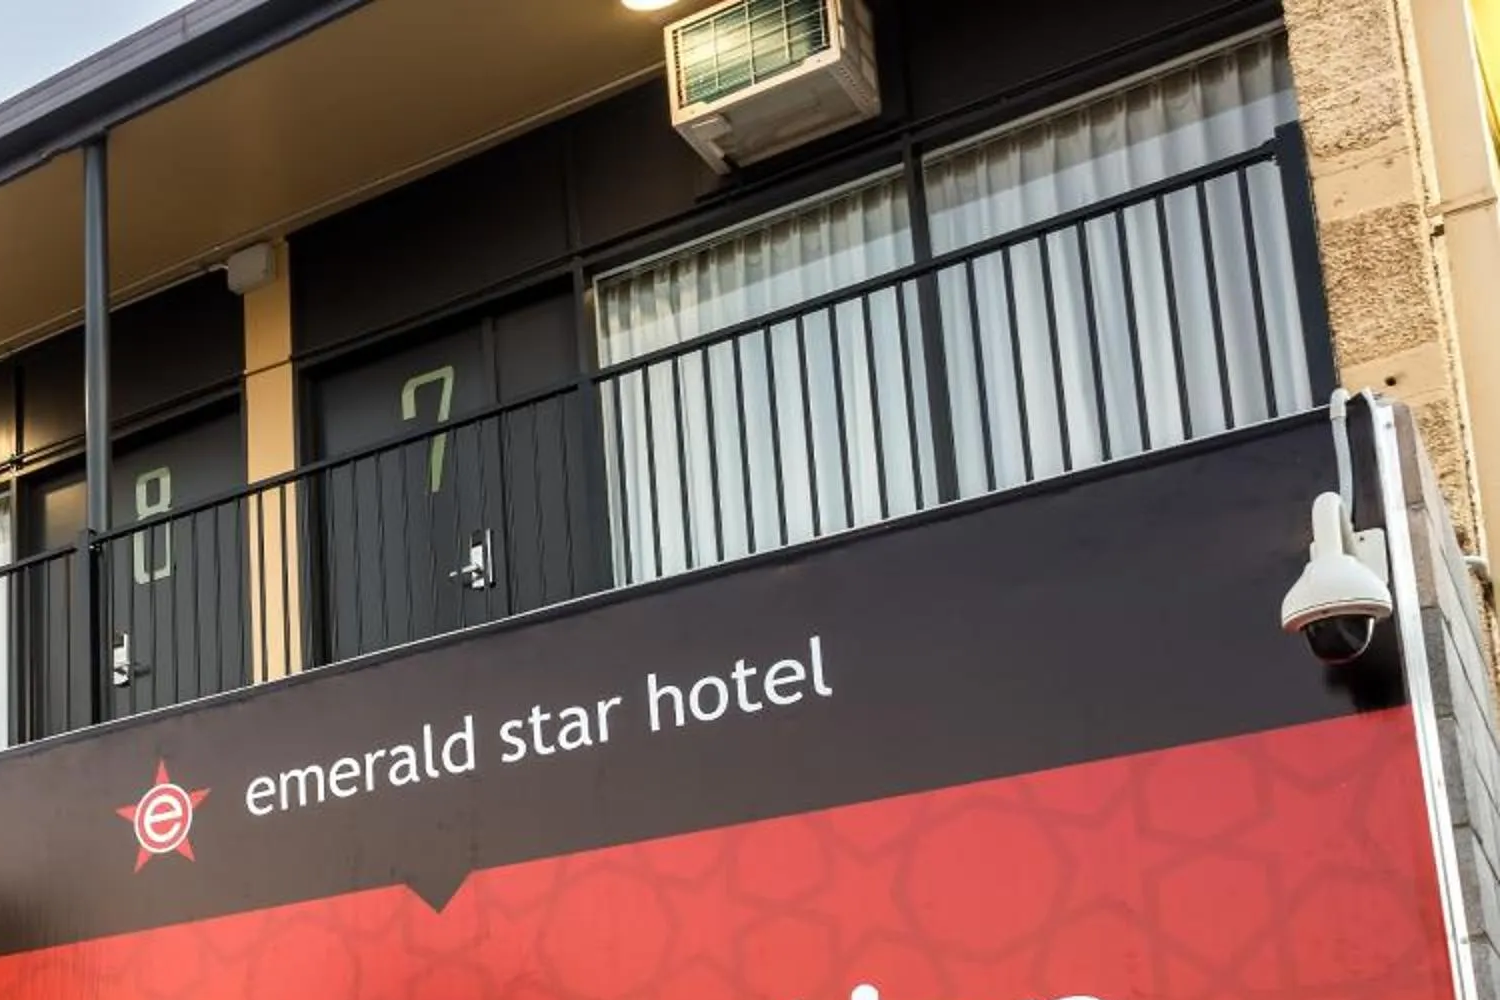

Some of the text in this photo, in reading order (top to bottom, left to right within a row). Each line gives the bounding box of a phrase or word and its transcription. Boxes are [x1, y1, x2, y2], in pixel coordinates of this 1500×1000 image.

[401, 365, 455, 492] 7
[133, 466, 171, 585] 8
[245, 635, 833, 817] emerald star hotel
[143, 793, 183, 843] e
